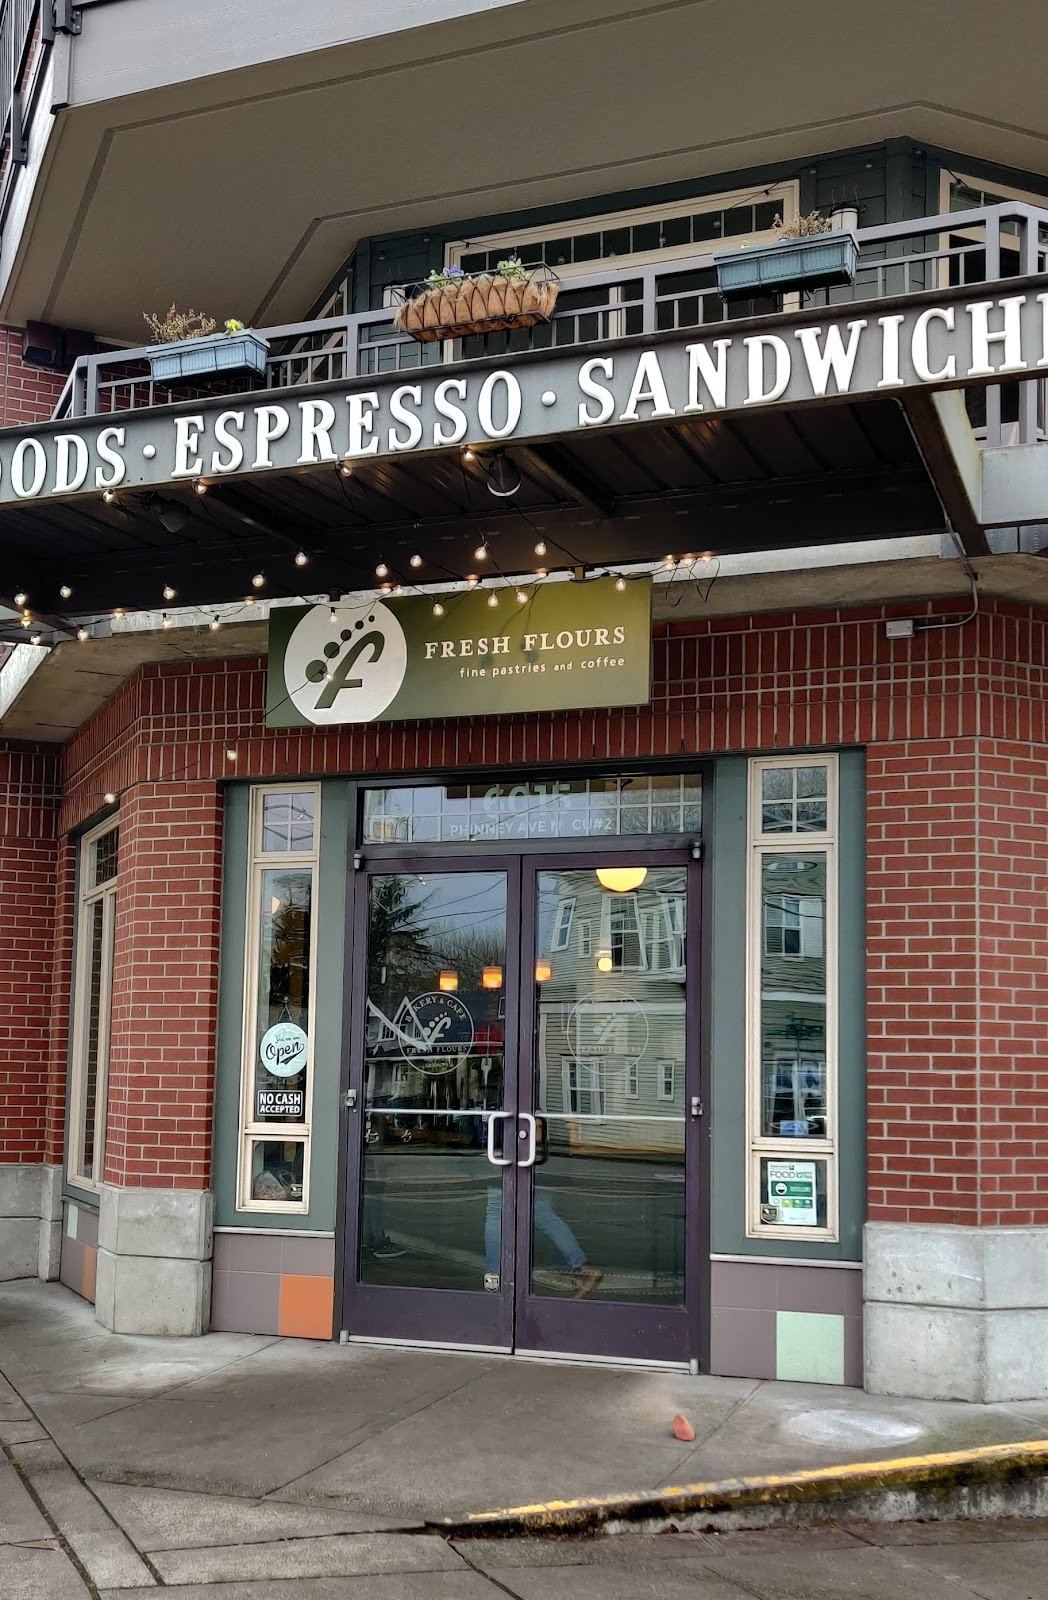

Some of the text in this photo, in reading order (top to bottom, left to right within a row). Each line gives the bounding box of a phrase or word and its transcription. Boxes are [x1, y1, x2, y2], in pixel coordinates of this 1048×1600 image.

[0, 293, 1048, 498] ODS ESPRESSO SANDWICH
[424, 626, 626, 659] FRESH FLOURS
[460, 656, 625, 678] fine pastries and coffee
[450, 822, 513, 836] PHINNEY
[517, 821, 547, 833] AVE
[405, 996, 438, 1022] BKERY
[266, 1042, 304, 1065] Open
[260, 1093, 301, 1105] NO CASH
[260, 1105, 300, 1113] ACCEPTED
[770, 1170, 795, 1178] FOOD
